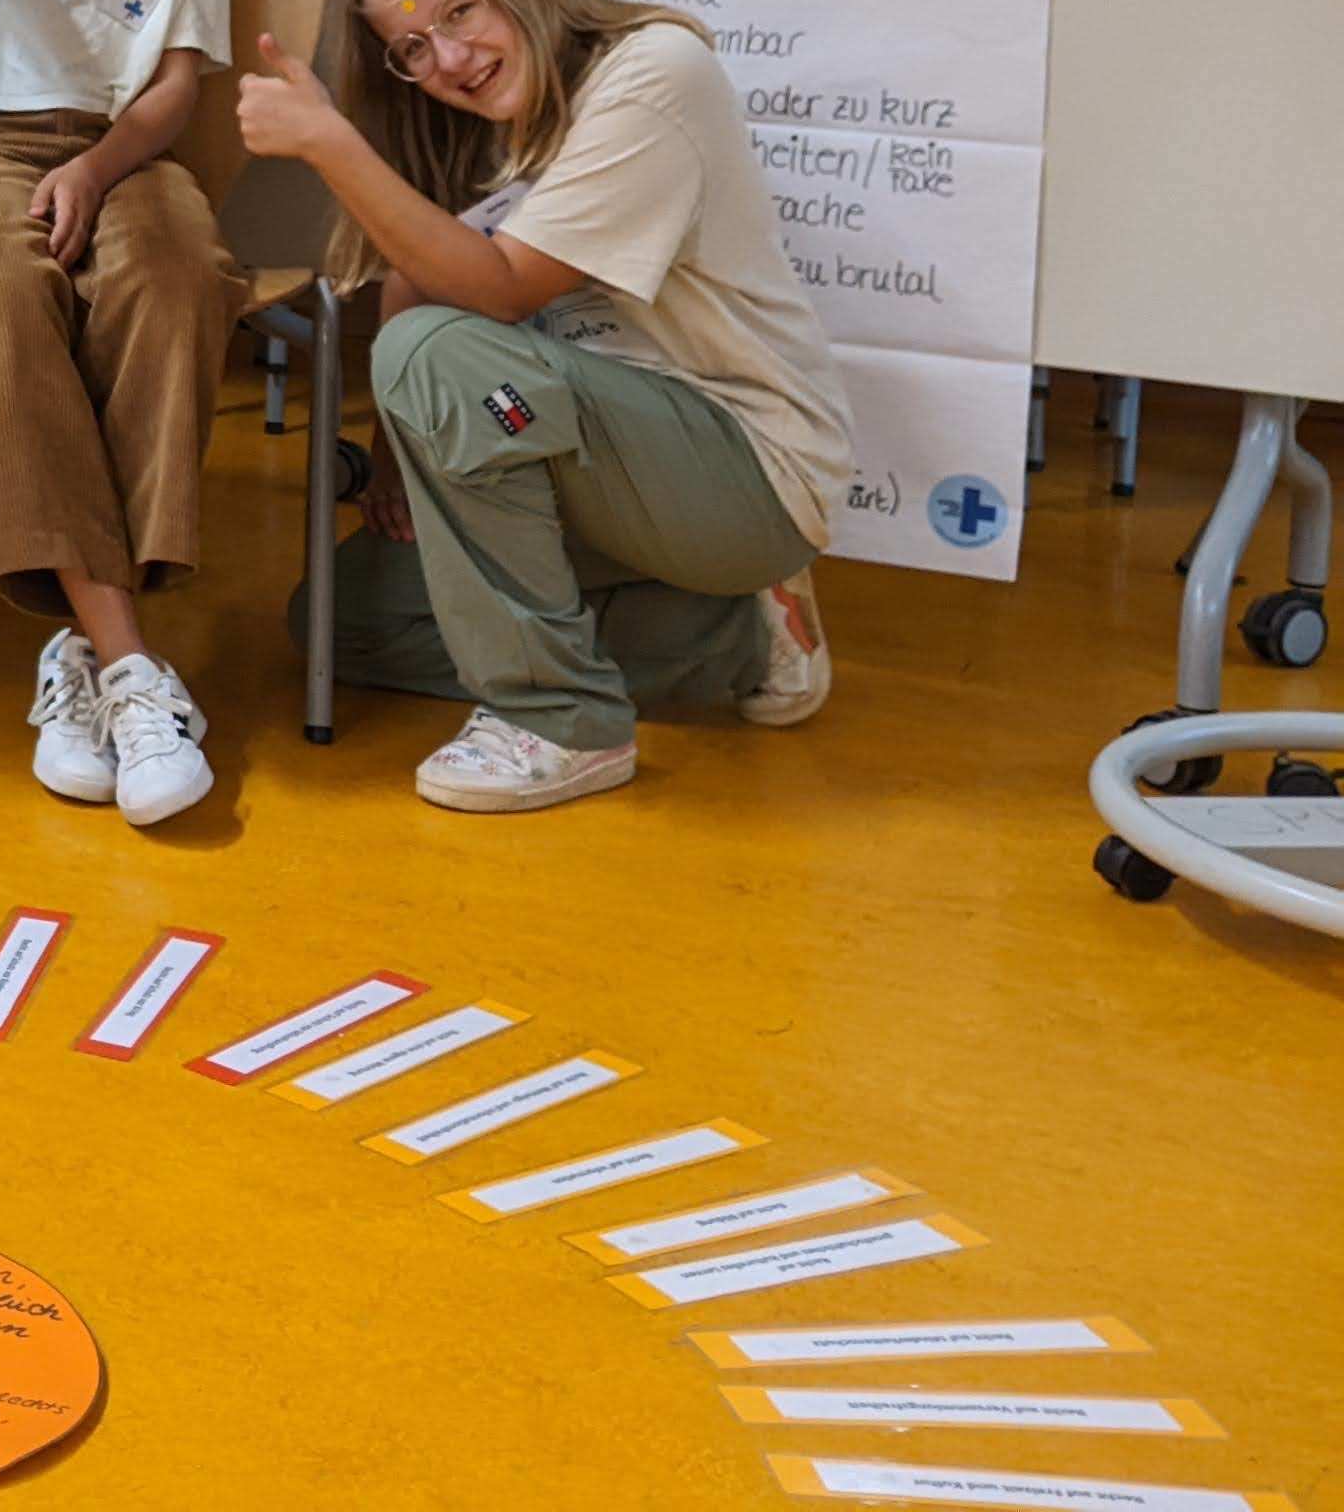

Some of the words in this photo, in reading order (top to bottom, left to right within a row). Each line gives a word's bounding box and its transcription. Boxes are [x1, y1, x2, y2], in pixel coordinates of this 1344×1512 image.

[712, 23, 807, 58] nnbar
[746, 85, 823, 119] oder
[832, 94, 869, 123] zu
[879, 89, 957, 128] kurz
[771, 192, 865, 232] ache
[836, 252, 943, 304] brutal
